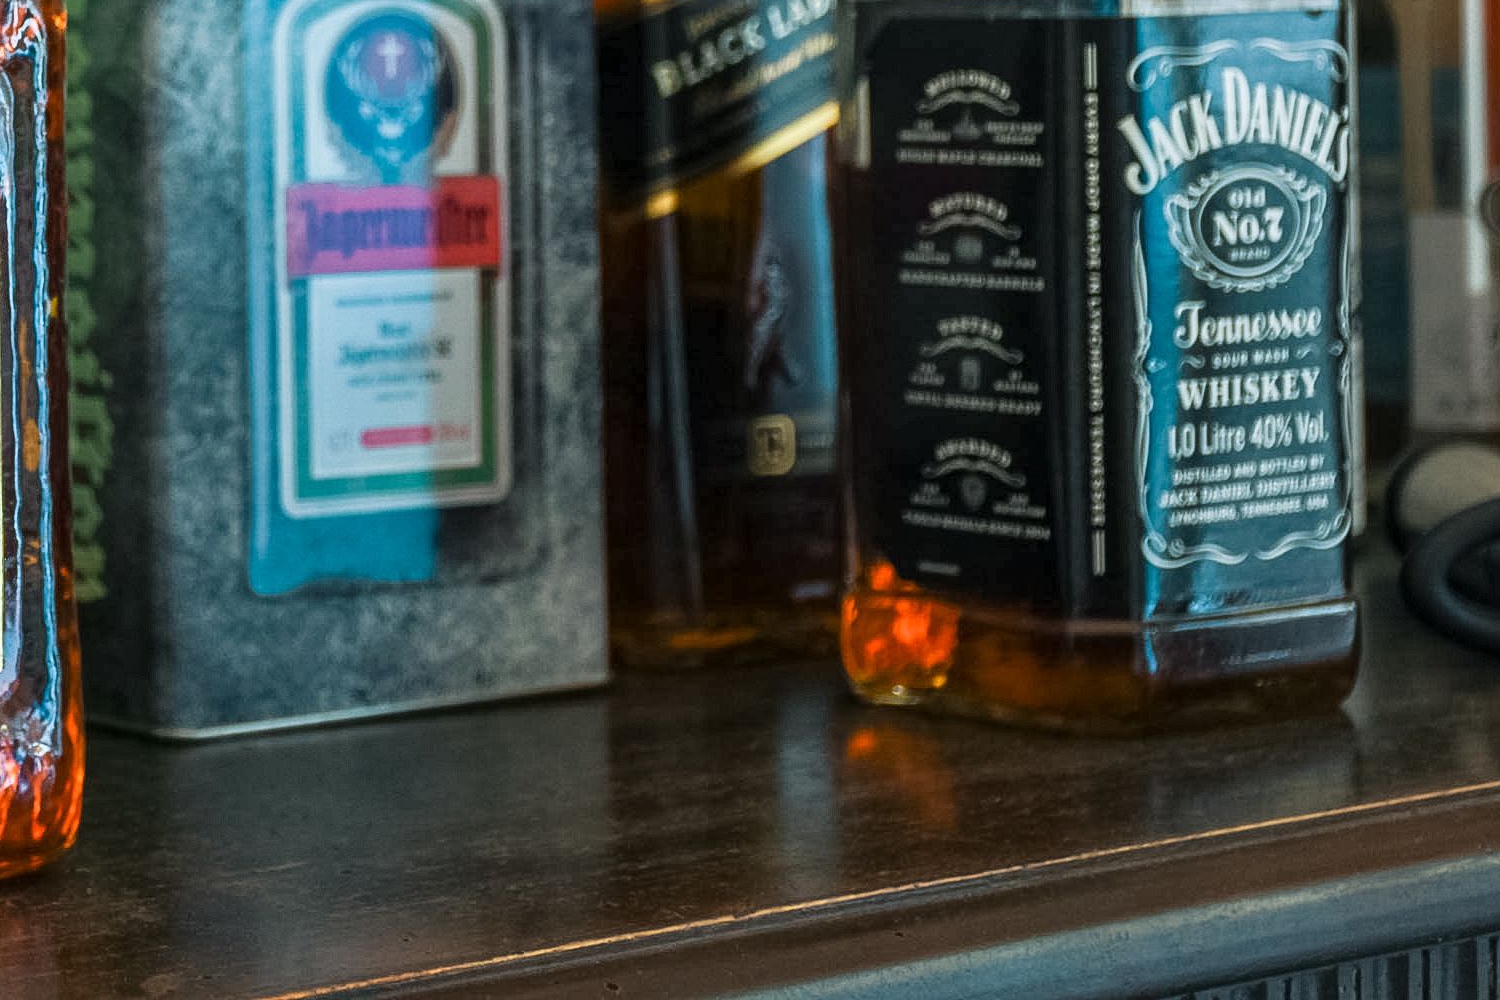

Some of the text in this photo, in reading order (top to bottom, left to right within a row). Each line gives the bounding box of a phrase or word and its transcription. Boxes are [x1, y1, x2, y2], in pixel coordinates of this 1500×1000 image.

[1116, 89, 1223, 195] JACK
[1228, 187, 1266, 209] Old
[1174, 300, 1322, 349] Tennessee
[1211, 345, 1290, 371] SOUR MASH
[1177, 366, 1321, 411] WHISKEY
[1201, 422, 1246, 456] Litre
[1251, 412, 1293, 449] 40%
[1259, 455, 1307, 476] BOTTLED
